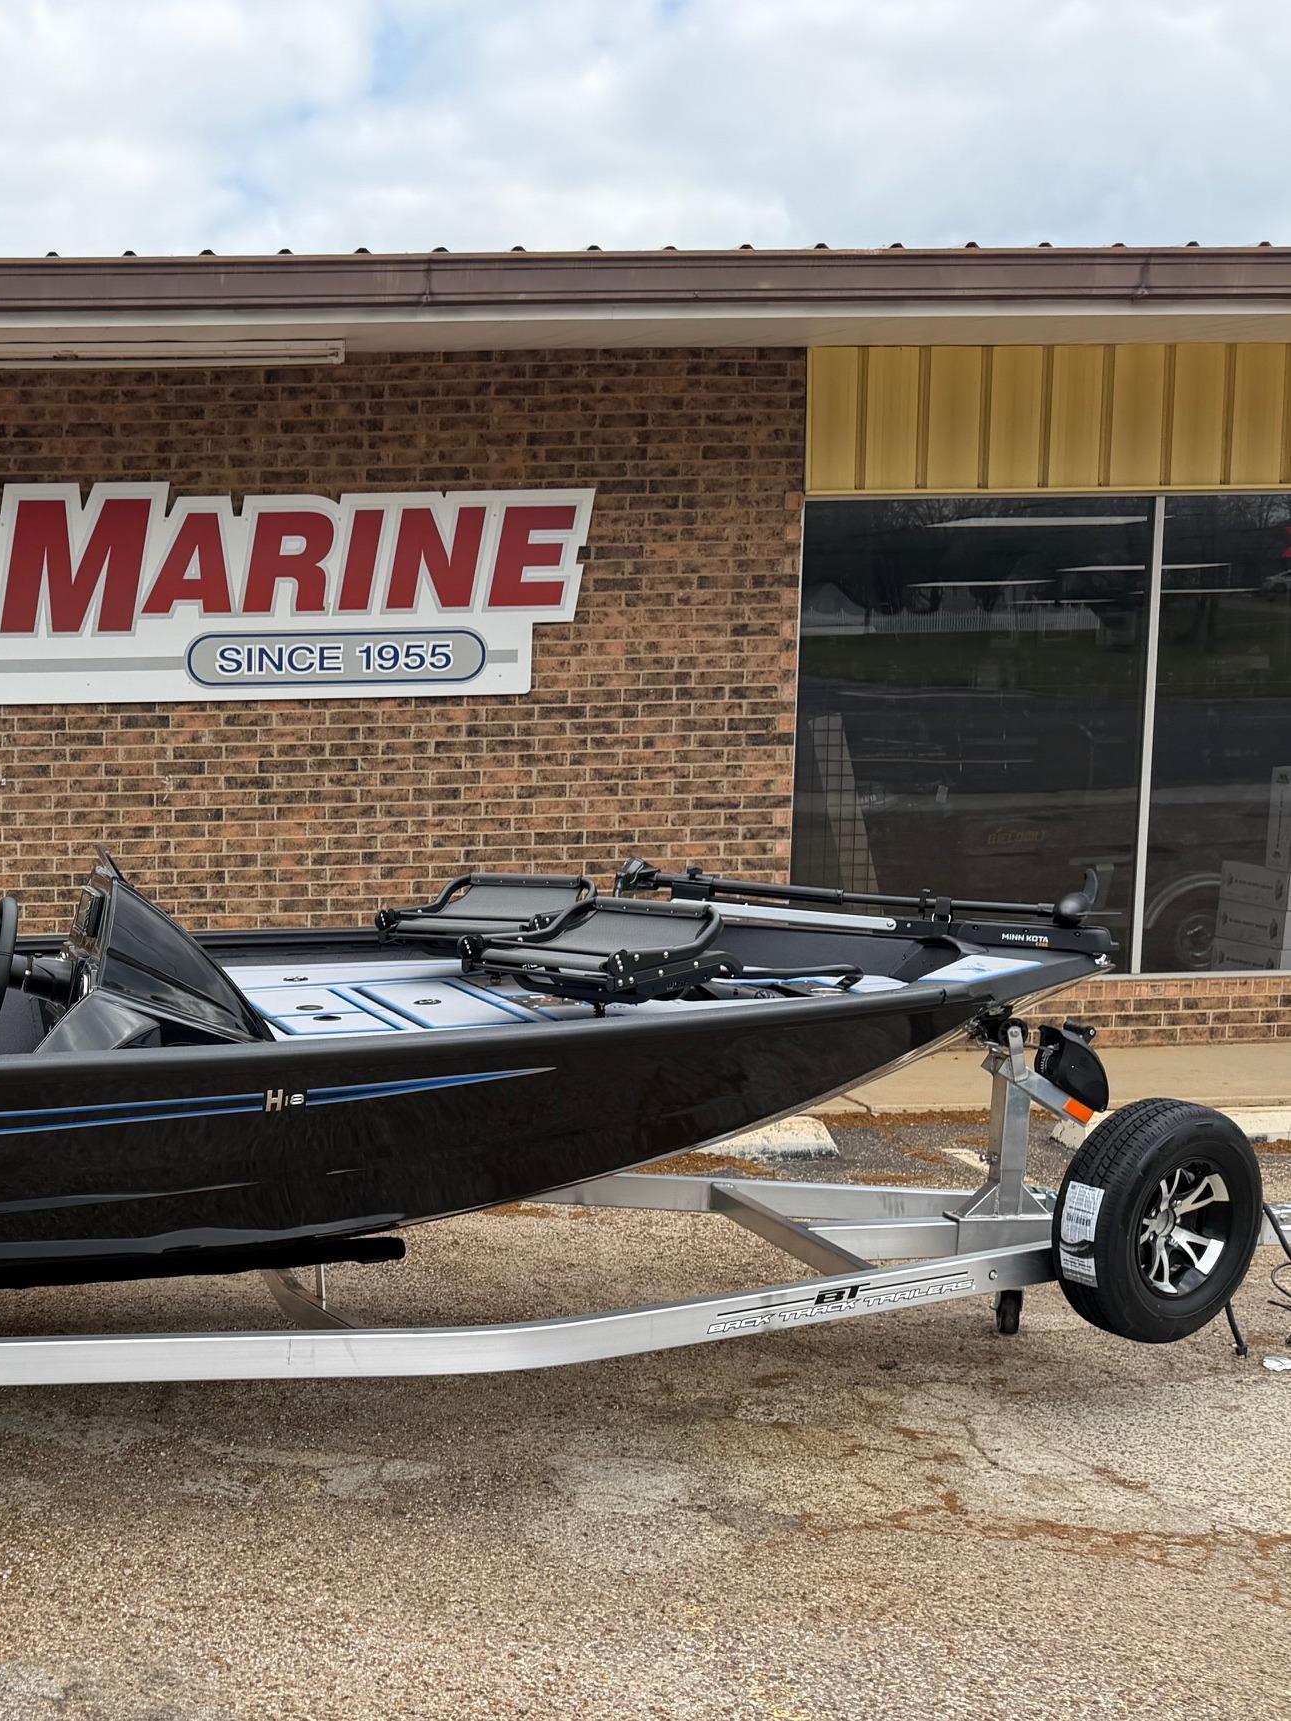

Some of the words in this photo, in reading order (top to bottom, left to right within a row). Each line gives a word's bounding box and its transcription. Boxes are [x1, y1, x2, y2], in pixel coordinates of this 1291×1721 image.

[0, 498, 578, 634] MARINE
[215, 643, 343, 676] SINCE
[357, 640, 454, 673] 1955
[1001, 933, 1025, 942] MINN
[1025, 935, 1049, 943] KOTA
[706, 1312, 776, 1334] BACK
[778, 1300, 858, 1323] TRACK
[863, 1278, 975, 1307] TRAILERS
[814, 1282, 870, 1306] BT
